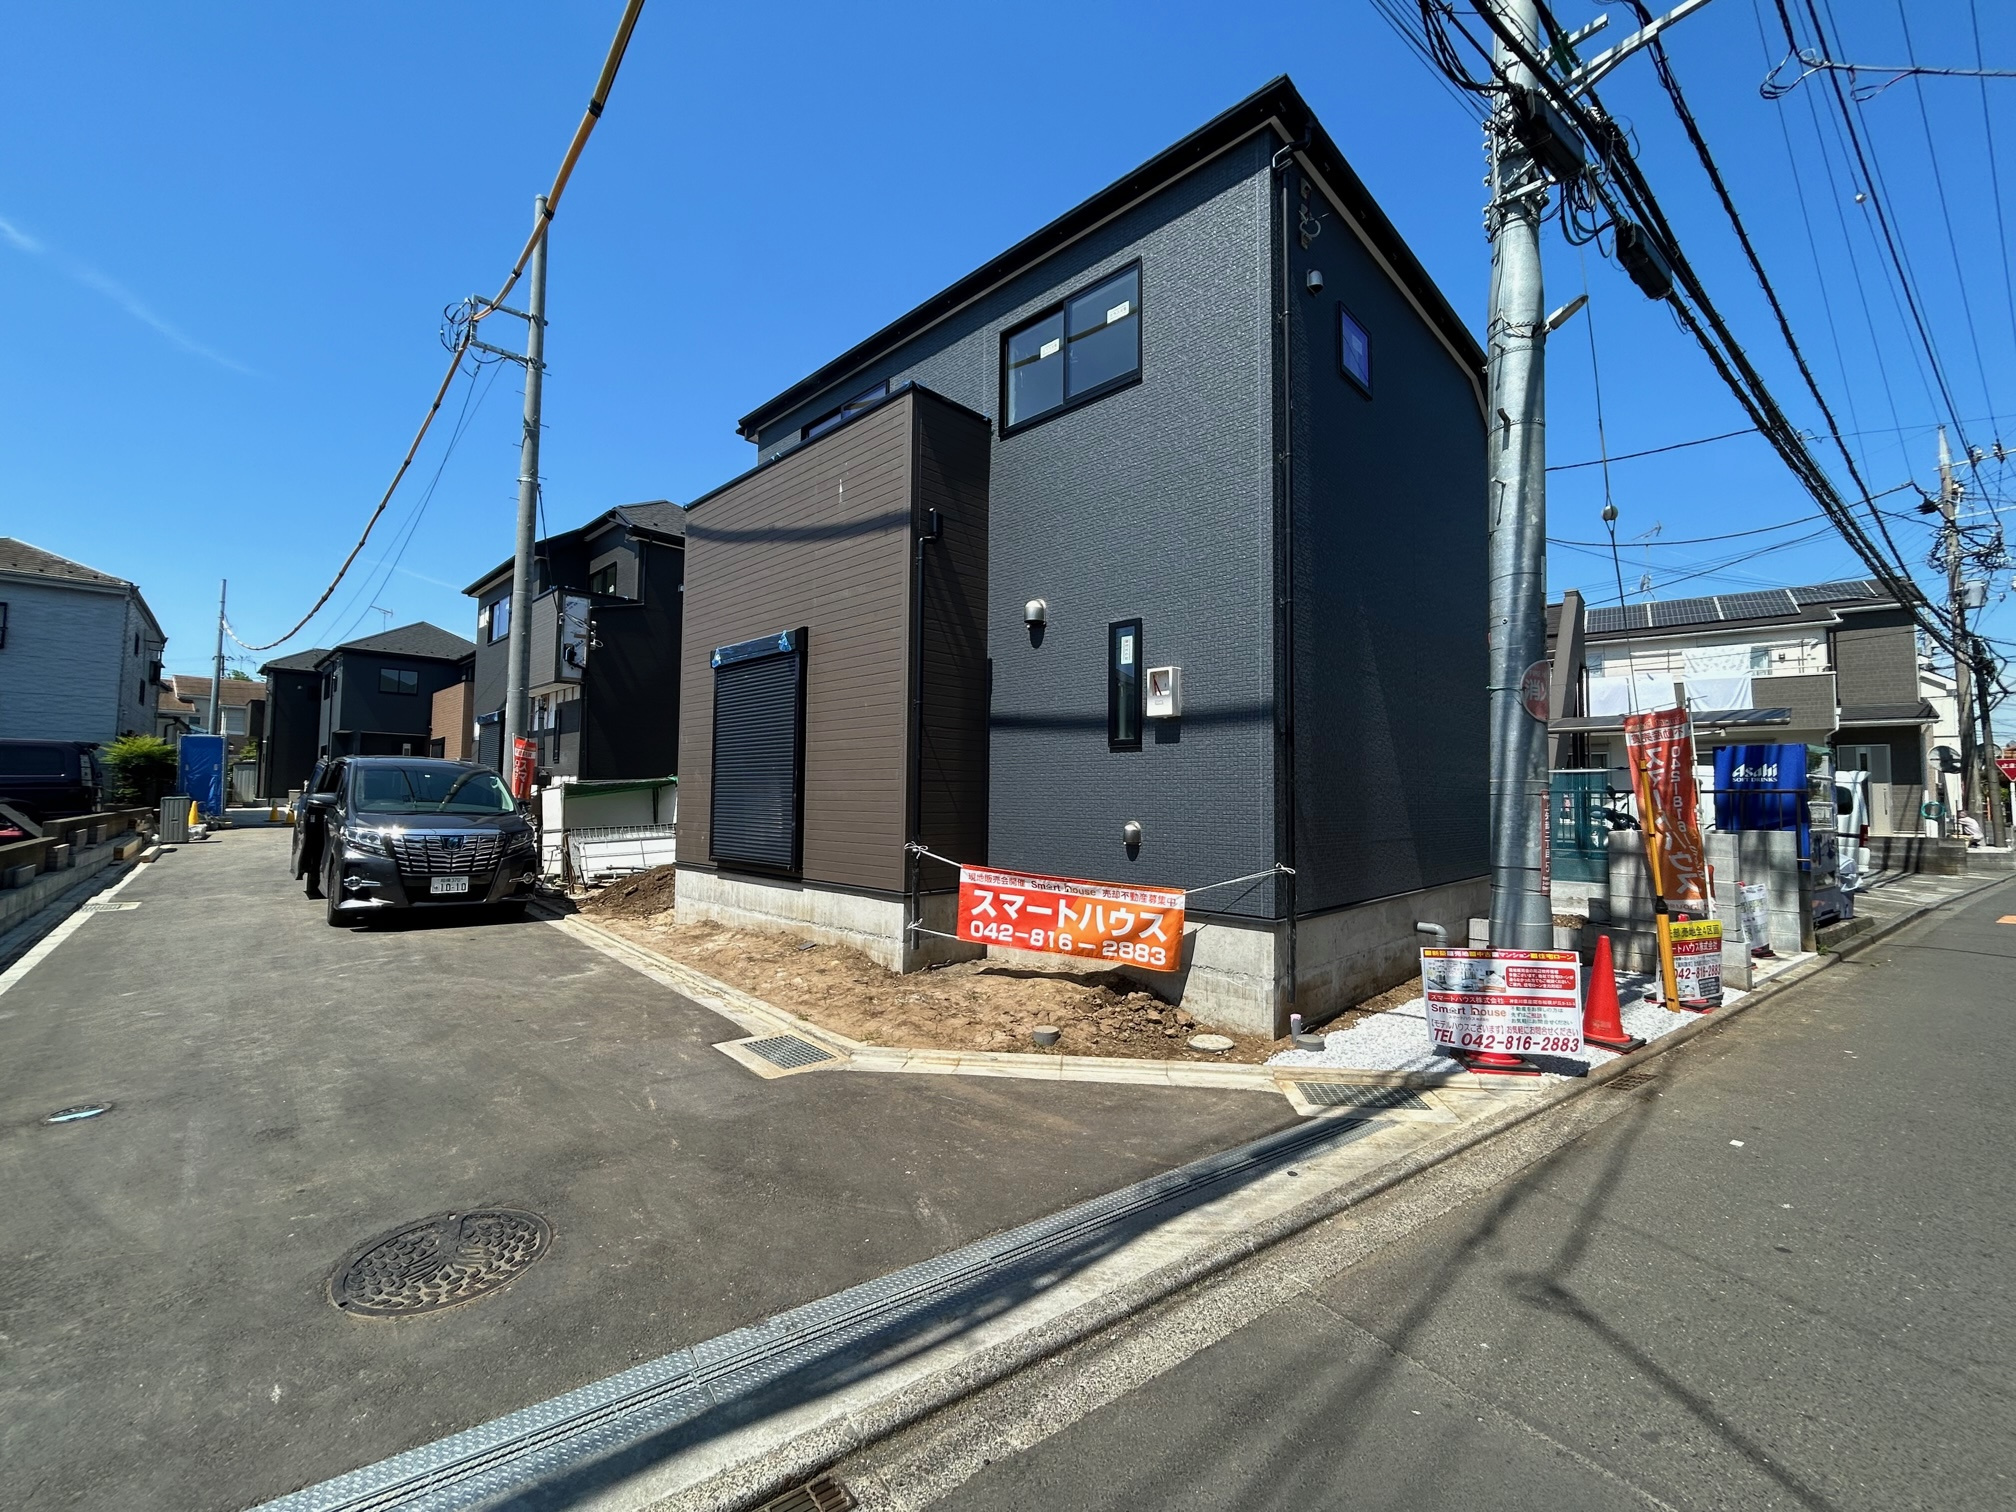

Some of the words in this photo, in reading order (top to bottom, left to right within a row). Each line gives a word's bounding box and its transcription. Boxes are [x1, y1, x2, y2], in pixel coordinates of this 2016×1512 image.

[1732, 763, 1778, 777] Asahi
[968, 872, 1025, 888] 現地販売会開催
[970, 889, 1168, 943] スマートハウス
[1470, 1005, 1507, 1017] house
[1434, 1028, 1455, 1044] TEL
[1461, 1033, 1580, 1052] 042-816-2883
